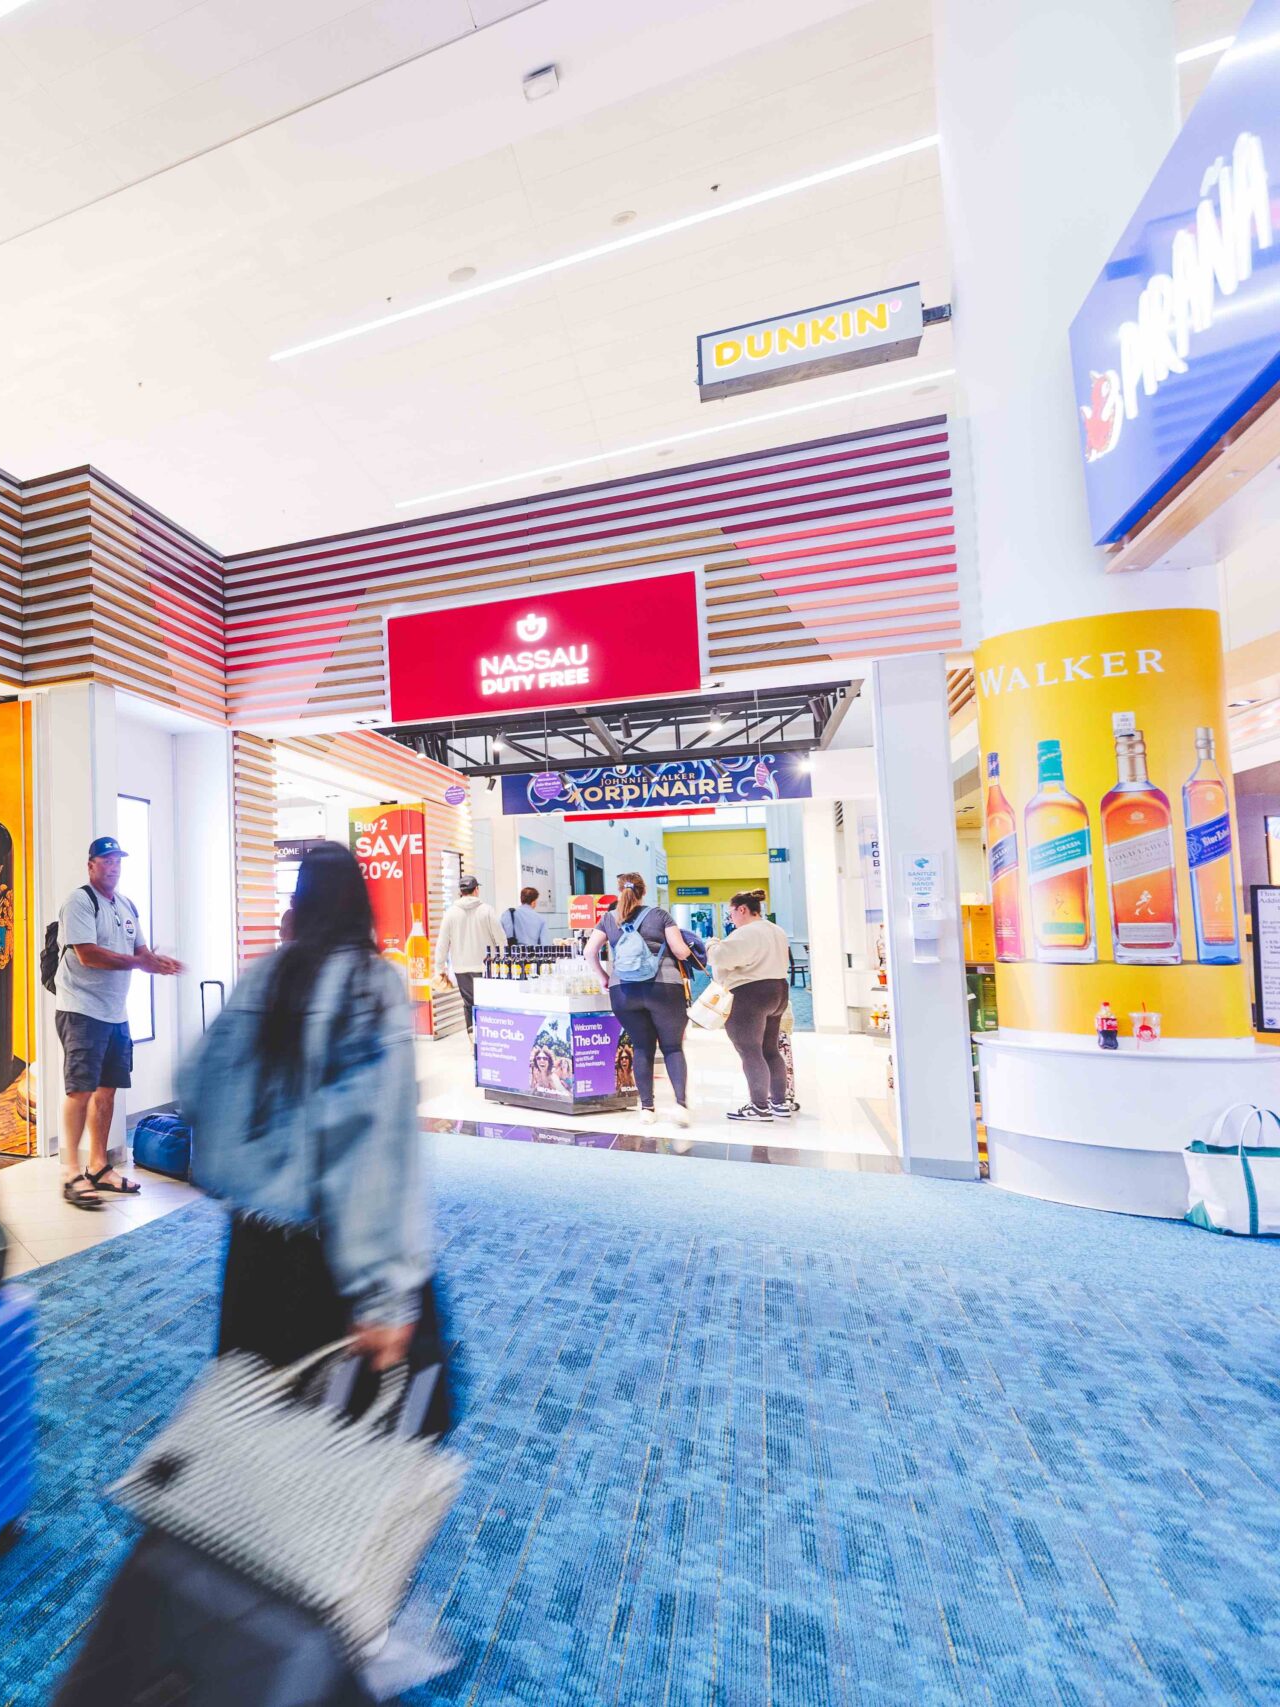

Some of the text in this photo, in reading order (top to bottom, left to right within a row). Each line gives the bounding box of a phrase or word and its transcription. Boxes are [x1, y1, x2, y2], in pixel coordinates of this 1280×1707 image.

[480, 643, 589, 677] NASSAU
[481, 667, 590, 696] DUTY FREE
[979, 649, 1165, 699] WALKER
[600, 777, 648, 787] JOHNNIE
[354, 818, 388, 835] Buy 2
[355, 833, 424, 858] SAVE
[480, 1026, 525, 1042] The Club
[574, 1033, 611, 1047] The Club
